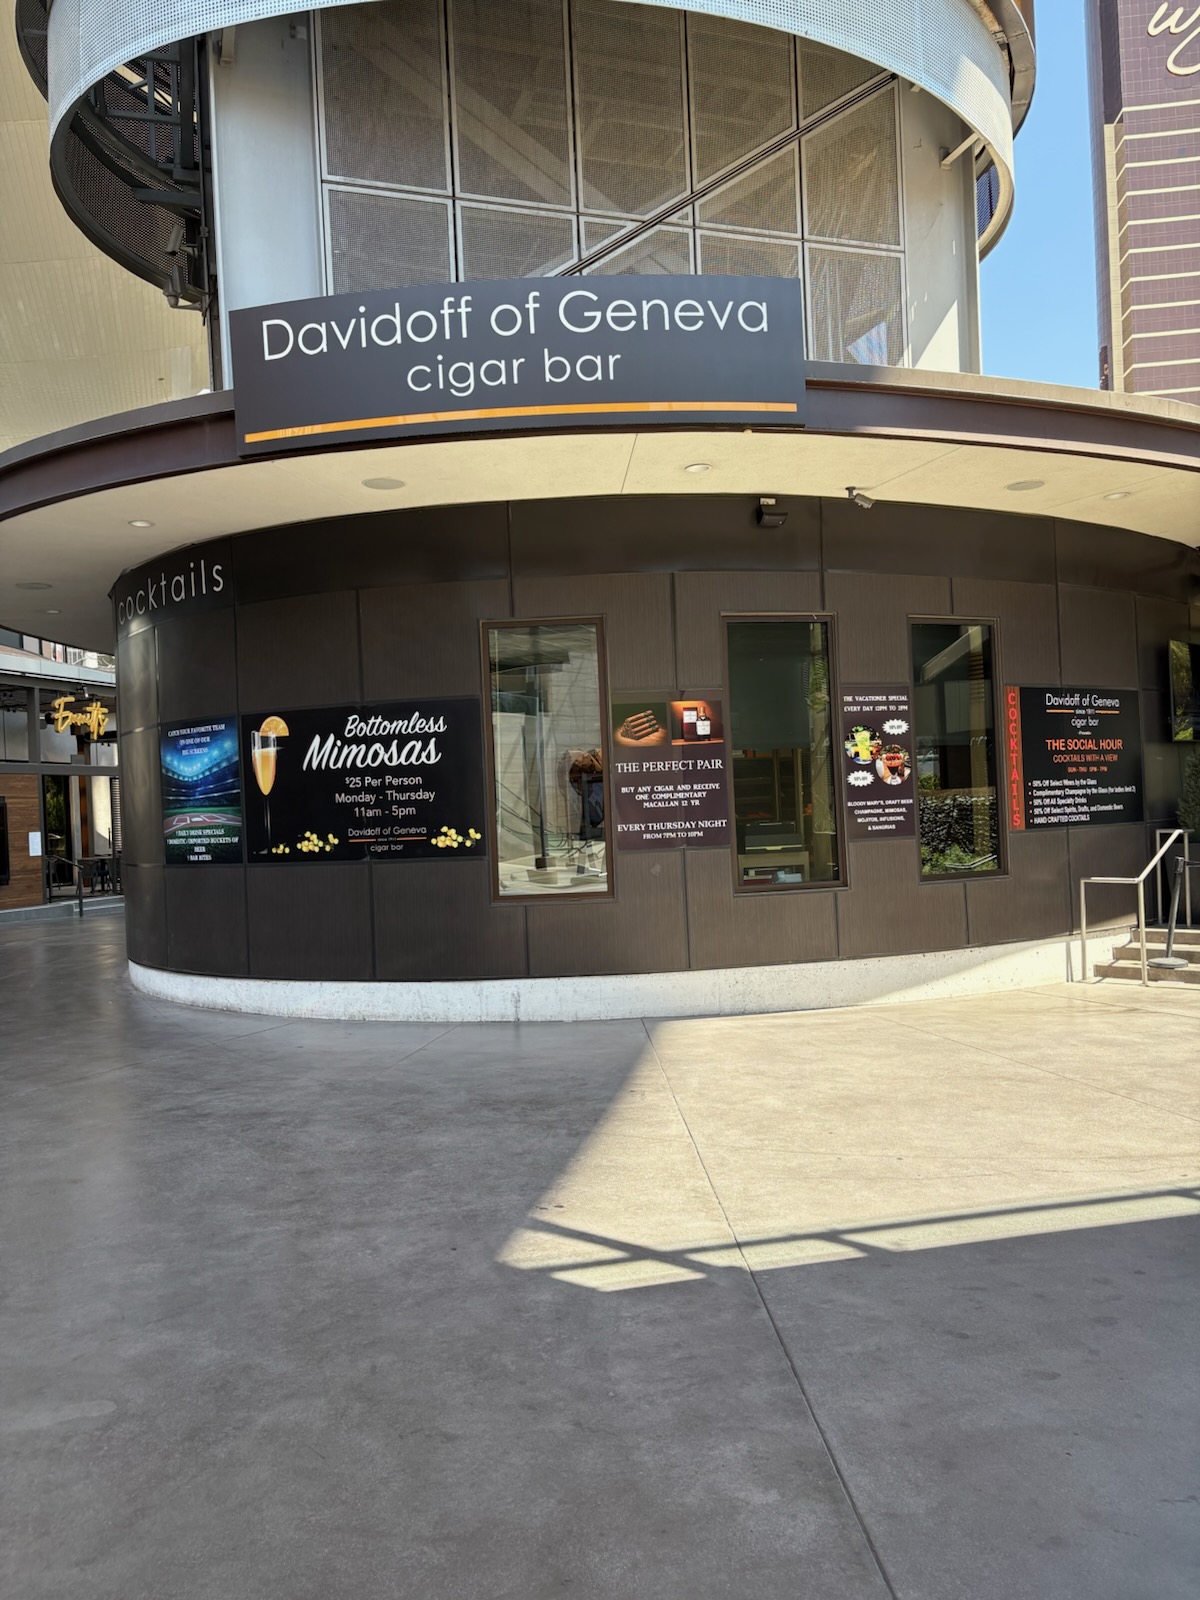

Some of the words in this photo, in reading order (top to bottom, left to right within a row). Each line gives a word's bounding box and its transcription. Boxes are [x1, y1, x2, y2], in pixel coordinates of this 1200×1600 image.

[261, 295, 473, 362] Davidoff
[490, 291, 540, 337] of
[558, 289, 769, 334] Geneva
[406, 354, 526, 398] cigar
[544, 348, 622, 384] bar
[118, 559, 224, 625] cocktails
[1046, 693, 1080, 706] Davidoff
[1082, 694, 1090, 706] of
[1092, 694, 1120, 707] Geneva
[344, 710, 448, 738] Bottomless
[1071, 716, 1087, 728] cigar
[1088, 716, 1099, 726] bar
[1046, 739, 1066, 751] THE
[1067, 739, 1098, 750] SOCIAL
[1100, 739, 1123, 750] HOUR
[302, 733, 442, 772] Mimosas
[1008, 692, 1020, 826] COCKTAILS
[1053, 754, 1085, 763] COCKTAILS
[616, 762, 640, 773] THE
[642, 760, 694, 772] PERFECT
[697, 759, 723, 770] PAIR
[345, 776, 361, 788] $25
[365, 776, 382, 787] Per
[385, 775, 422, 786] Person
[335, 791, 376, 805] Monday
[385, 789, 435, 802] Thursday
[652, 792, 707, 800] COMPLIMENTARY
[354, 807, 382, 817] 11am
[392, 805, 416, 819] 5pm
[348, 827, 380, 836] Davidoff
[382, 827, 391, 835] of
[393, 826, 427, 835] Geneva
[617, 824, 646, 832] EVERY
[647, 821, 696, 831] THURSDAY
[698, 820, 727, 828] NIGHT
